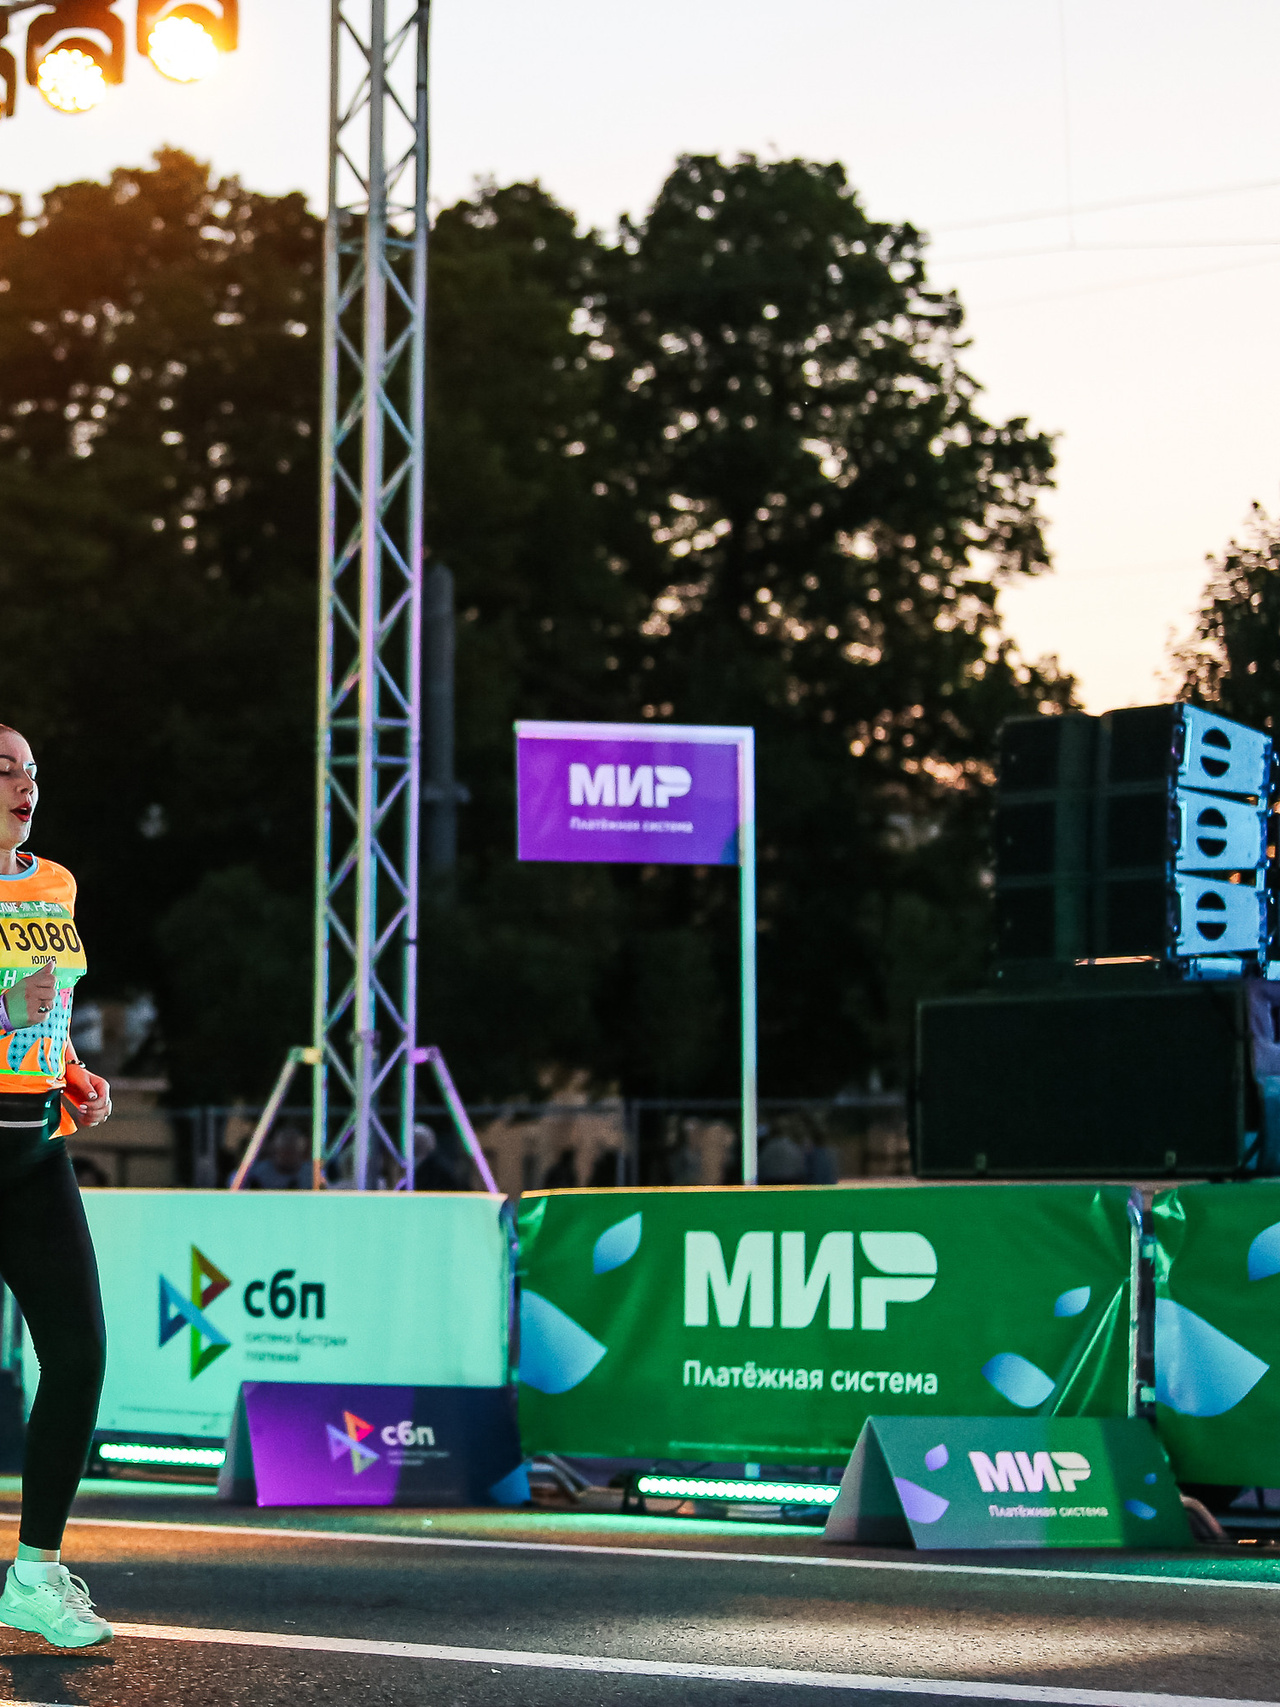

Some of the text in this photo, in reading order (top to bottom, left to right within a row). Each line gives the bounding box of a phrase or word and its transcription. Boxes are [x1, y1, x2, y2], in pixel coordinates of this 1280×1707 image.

[568, 762, 693, 808] МИР
[243, 1269, 326, 1320] сбп
[683, 1230, 938, 1331] МИР
[683, 1359, 939, 1396] Платёжная система
[380, 1420, 436, 1446] сбп
[968, 1450, 1092, 1493] МИР
